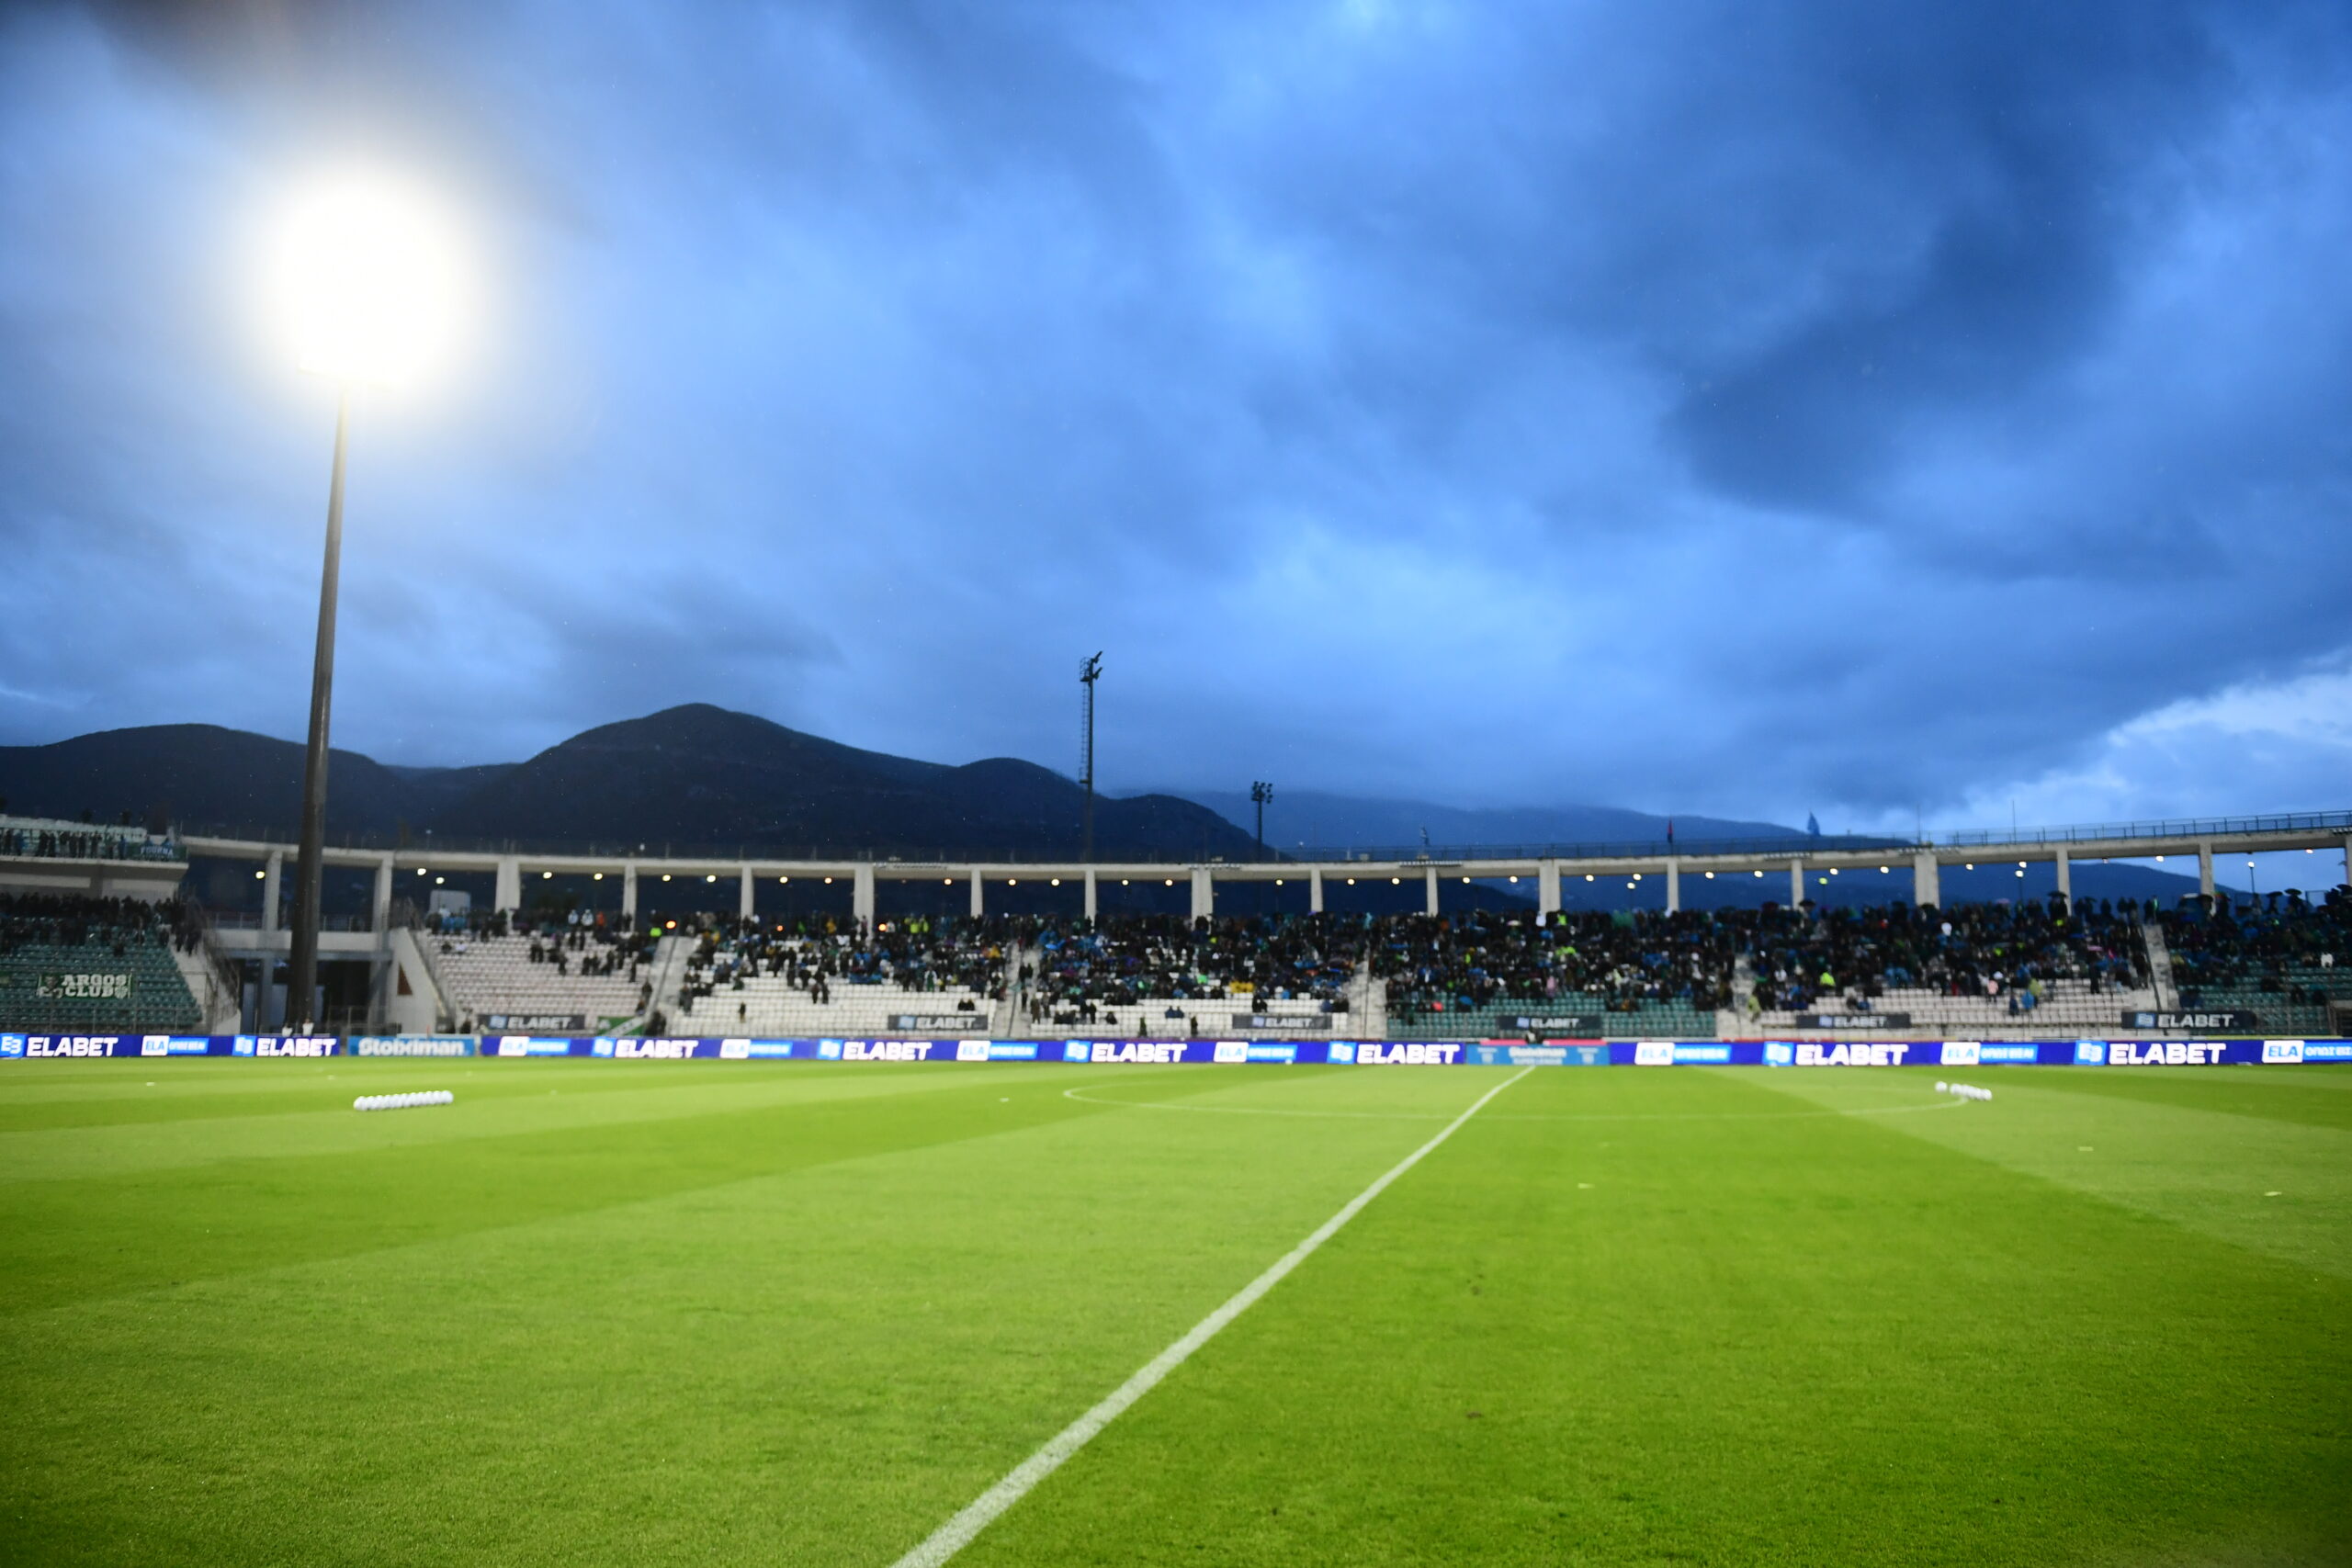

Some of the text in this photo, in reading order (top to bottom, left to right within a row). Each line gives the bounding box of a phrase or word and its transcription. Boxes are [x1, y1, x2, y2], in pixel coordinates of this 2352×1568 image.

[62, 974, 127, 986] ARGOS
[508, 1017, 571, 1029] ELABET
[915, 1017, 976, 1029] ELABET
[1265, 1018, 1312, 1028] ELABET
[1531, 1018, 1579, 1028] ELABET
[1834, 1017, 1886, 1027] ELABET
[2157, 1014, 2233, 1028] ELABET
[26, 1037, 119, 1057] ELABET
[255, 1038, 337, 1056] ELABET
[614, 1039, 700, 1059] ELABET
[842, 1041, 933, 1061] ELABET
[1091, 1043, 1189, 1063] ELABET
[1356, 1043, 1462, 1064] ELABET
[1795, 1044, 1909, 1066] ELABET
[2109, 1043, 2228, 1064] ELABET
[2267, 1045, 2299, 1057] ELA
